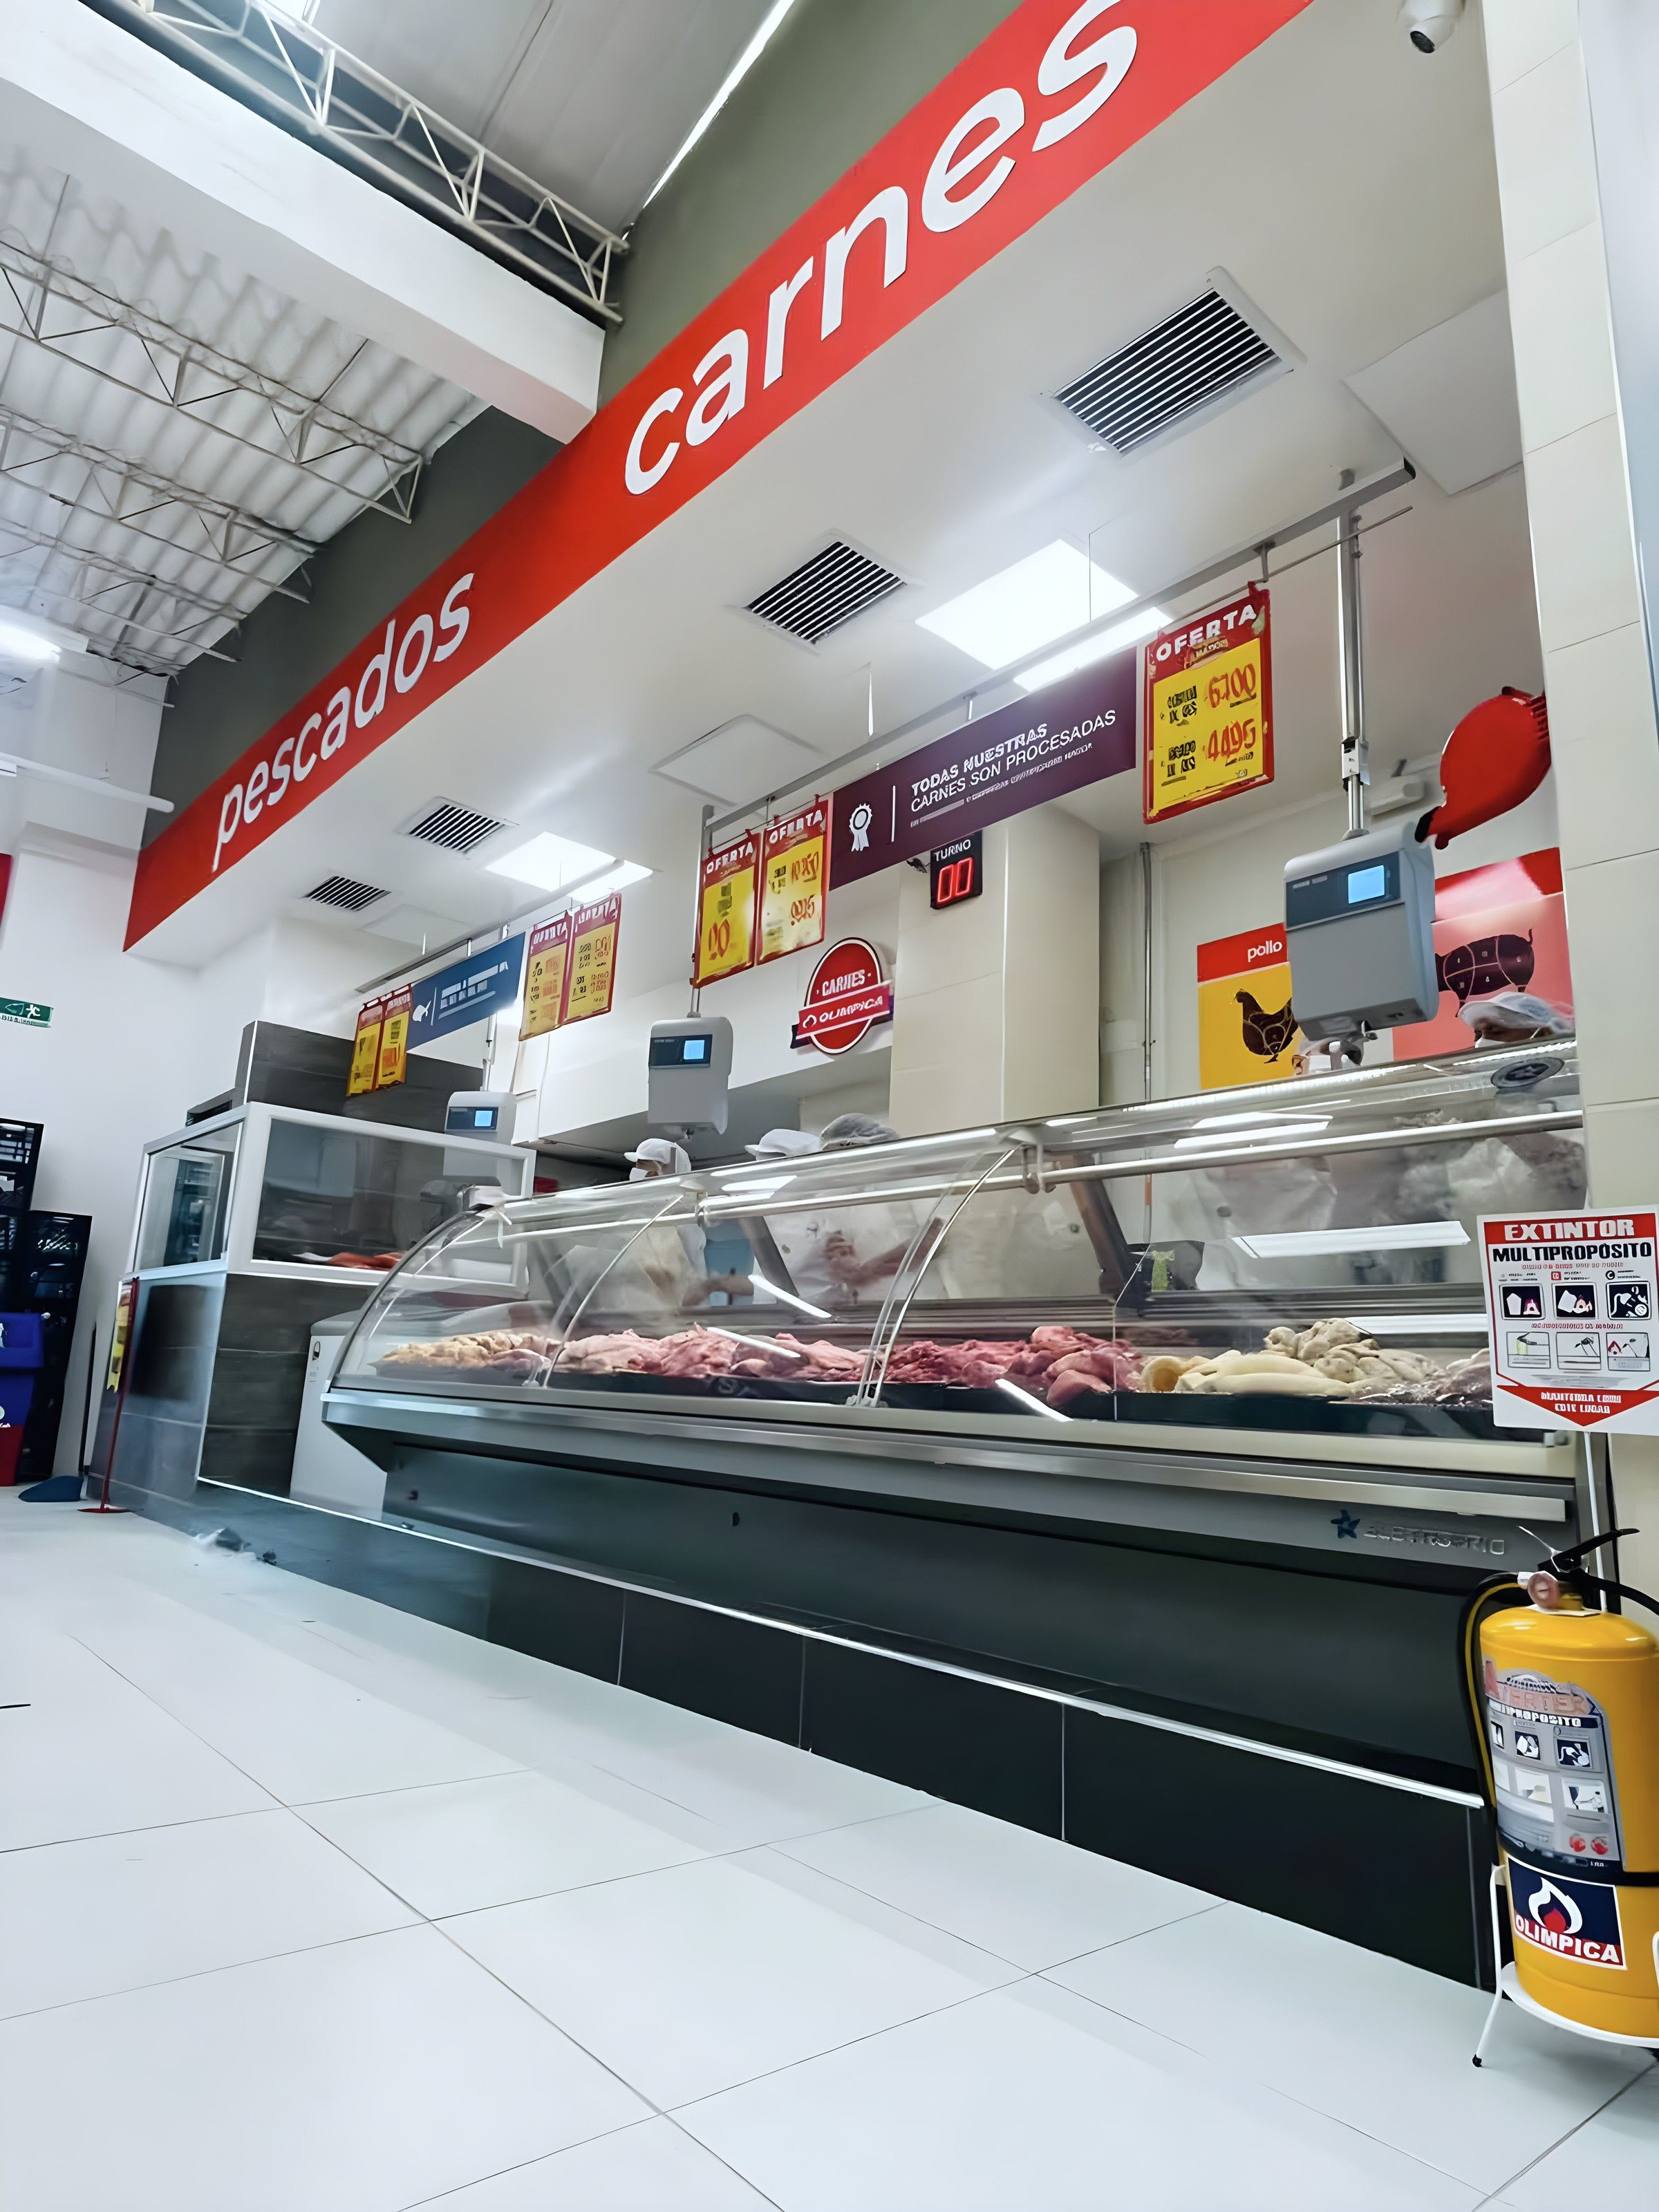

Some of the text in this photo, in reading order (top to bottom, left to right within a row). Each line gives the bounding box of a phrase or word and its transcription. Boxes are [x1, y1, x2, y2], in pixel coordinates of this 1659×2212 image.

[624, 0, 1137, 494] carnes
[1156, 605, 1257, 662] OFERTA
[212, 573, 475, 872] pescados
[911, 765, 959, 796] TODAS
[964, 723, 1048, 772] NUESTRAS
[911, 777, 966, 812] CARNES
[970, 762, 1001, 787] SON
[1006, 709, 1116, 771] PROCESADAS
[706, 841, 753, 874] OFERTA
[934, 838, 971, 862] TURNO
[1247, 939, 1283, 963] pollo
[1504, 1219, 1635, 1241] EXTINTOR
[1515, 1913, 1620, 1963] OLIMPICA
